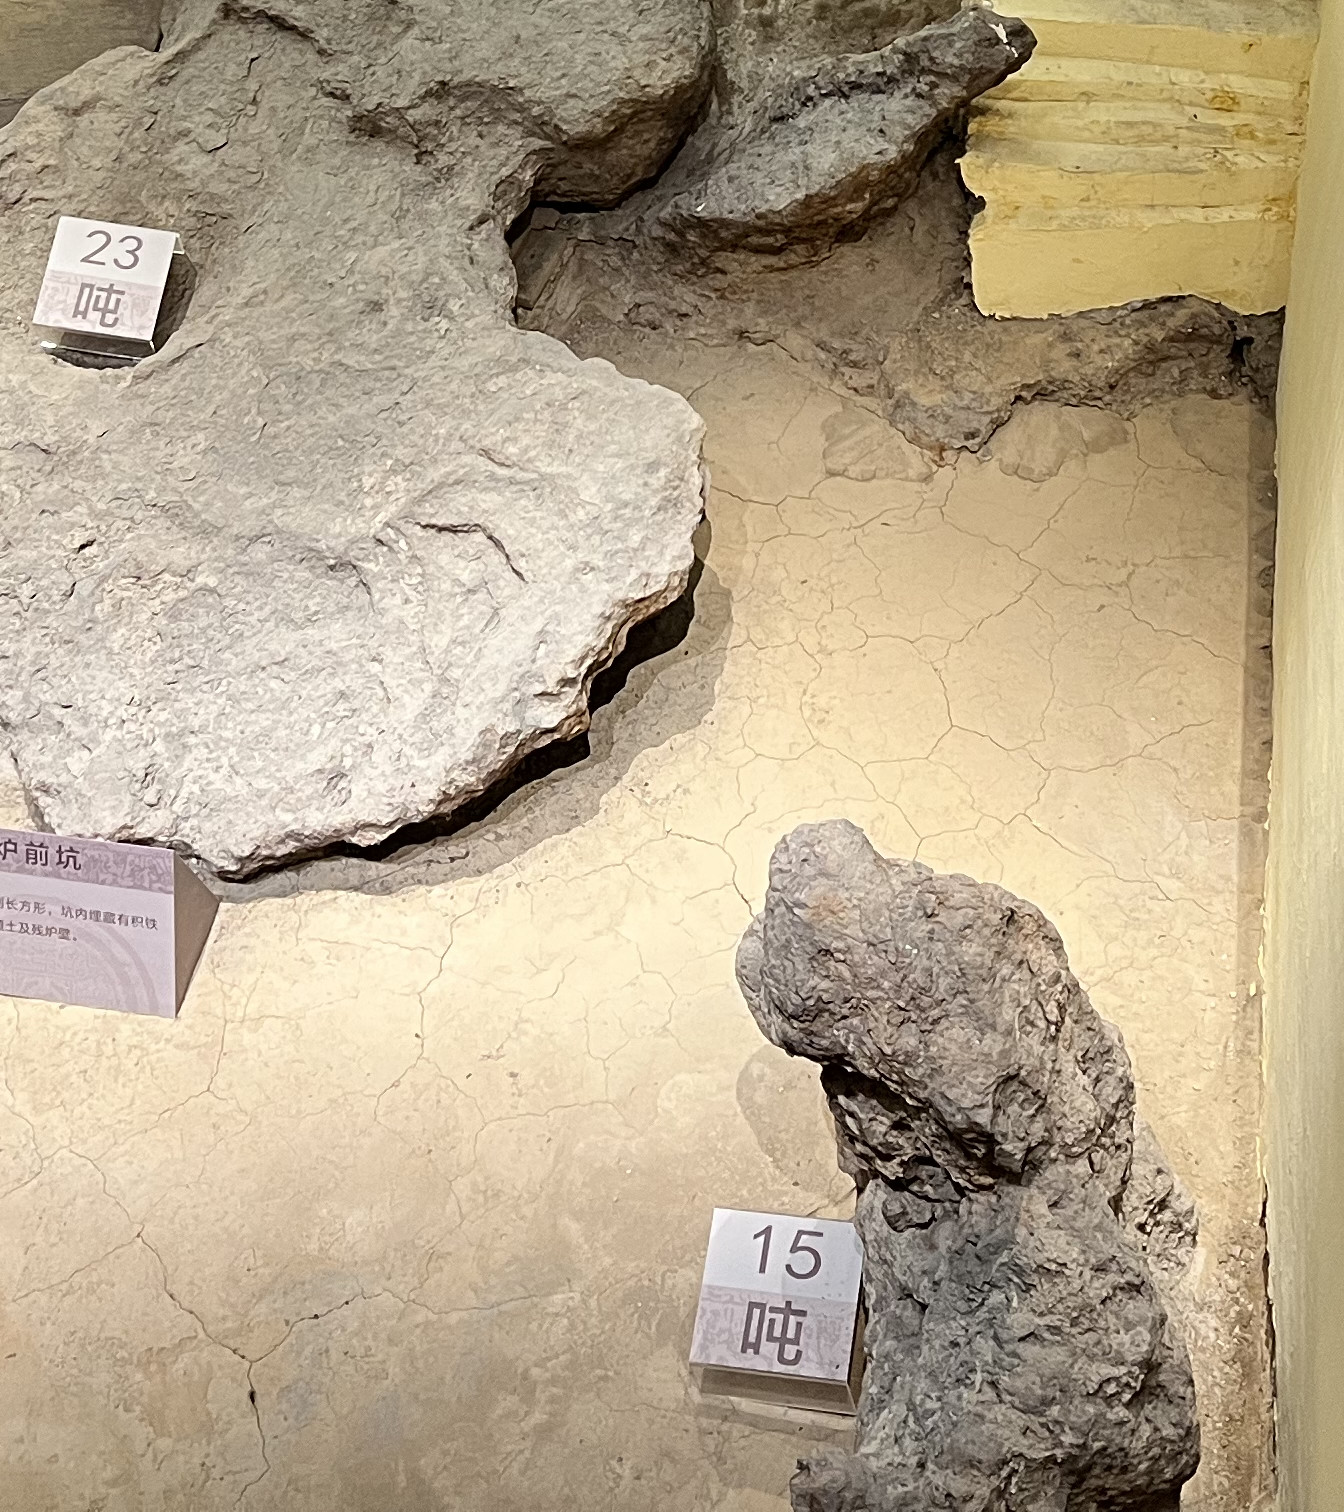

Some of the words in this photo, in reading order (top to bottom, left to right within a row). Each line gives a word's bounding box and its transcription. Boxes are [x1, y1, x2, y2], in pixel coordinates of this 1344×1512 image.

[79, 230, 144, 270] 23
[71, 282, 126, 328] 吨
[752, 1224, 824, 1280] 15
[740, 1300, 808, 1366] 吨
